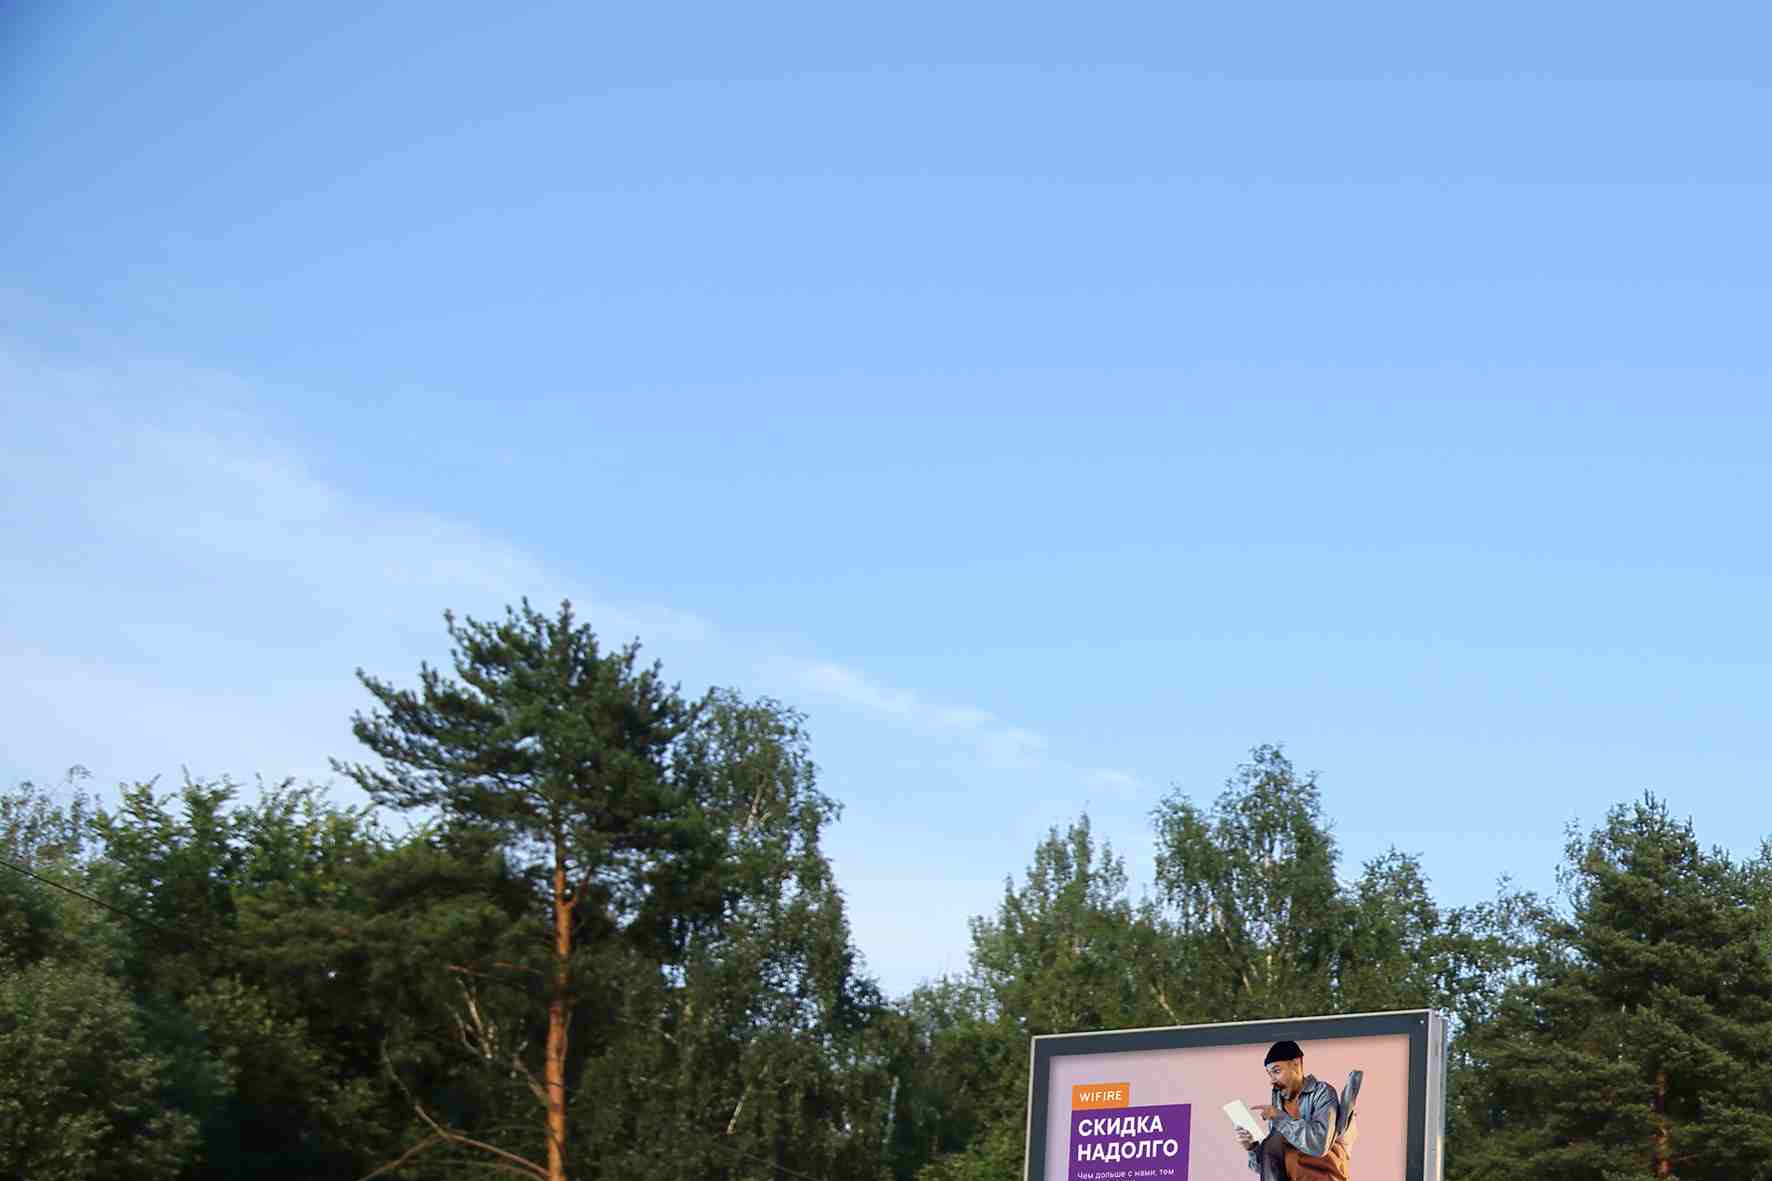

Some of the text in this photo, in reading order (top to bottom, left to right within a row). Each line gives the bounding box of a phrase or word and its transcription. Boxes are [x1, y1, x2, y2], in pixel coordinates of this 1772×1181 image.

[1079, 1090, 1123, 1102] WIFIRE
[1078, 1115, 1163, 1138] СКИДКА
[1077, 1138, 1179, 1163] НАДОЛГО
[1077, 1171, 1094, 1180] Чем
[1095, 1171, 1125, 1179] дольше
[1127, 1170, 1133, 1178] с
[1160, 1168, 1175, 1177] тем
